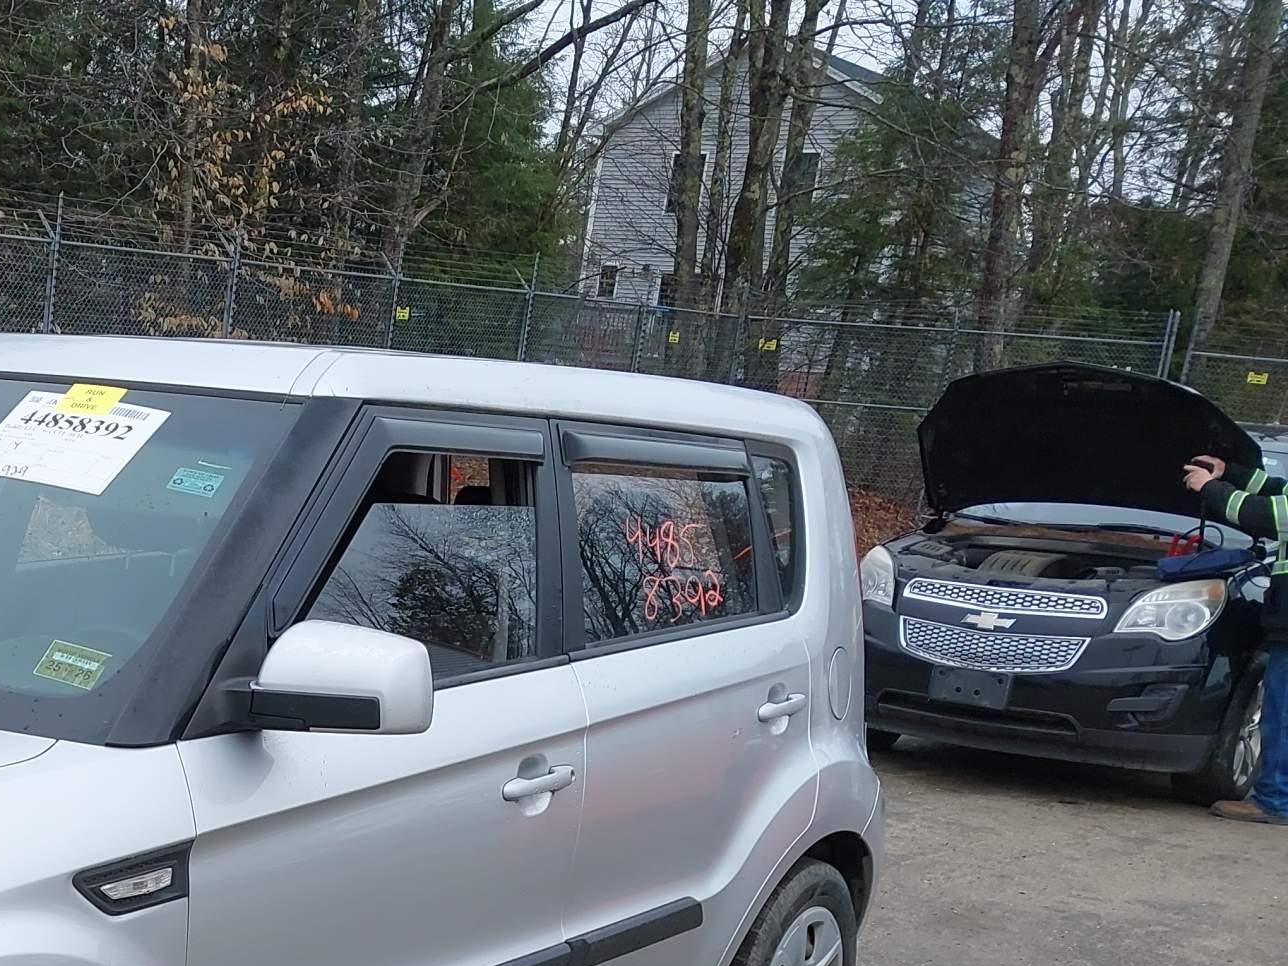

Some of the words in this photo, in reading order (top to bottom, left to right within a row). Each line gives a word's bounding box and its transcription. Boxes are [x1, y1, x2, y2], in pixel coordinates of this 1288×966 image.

[20, 410, 133, 441] 44858392
[70, 402, 98, 410] DRIVE
[626, 512, 707, 569] 4485
[643, 569, 724, 623] 8392
